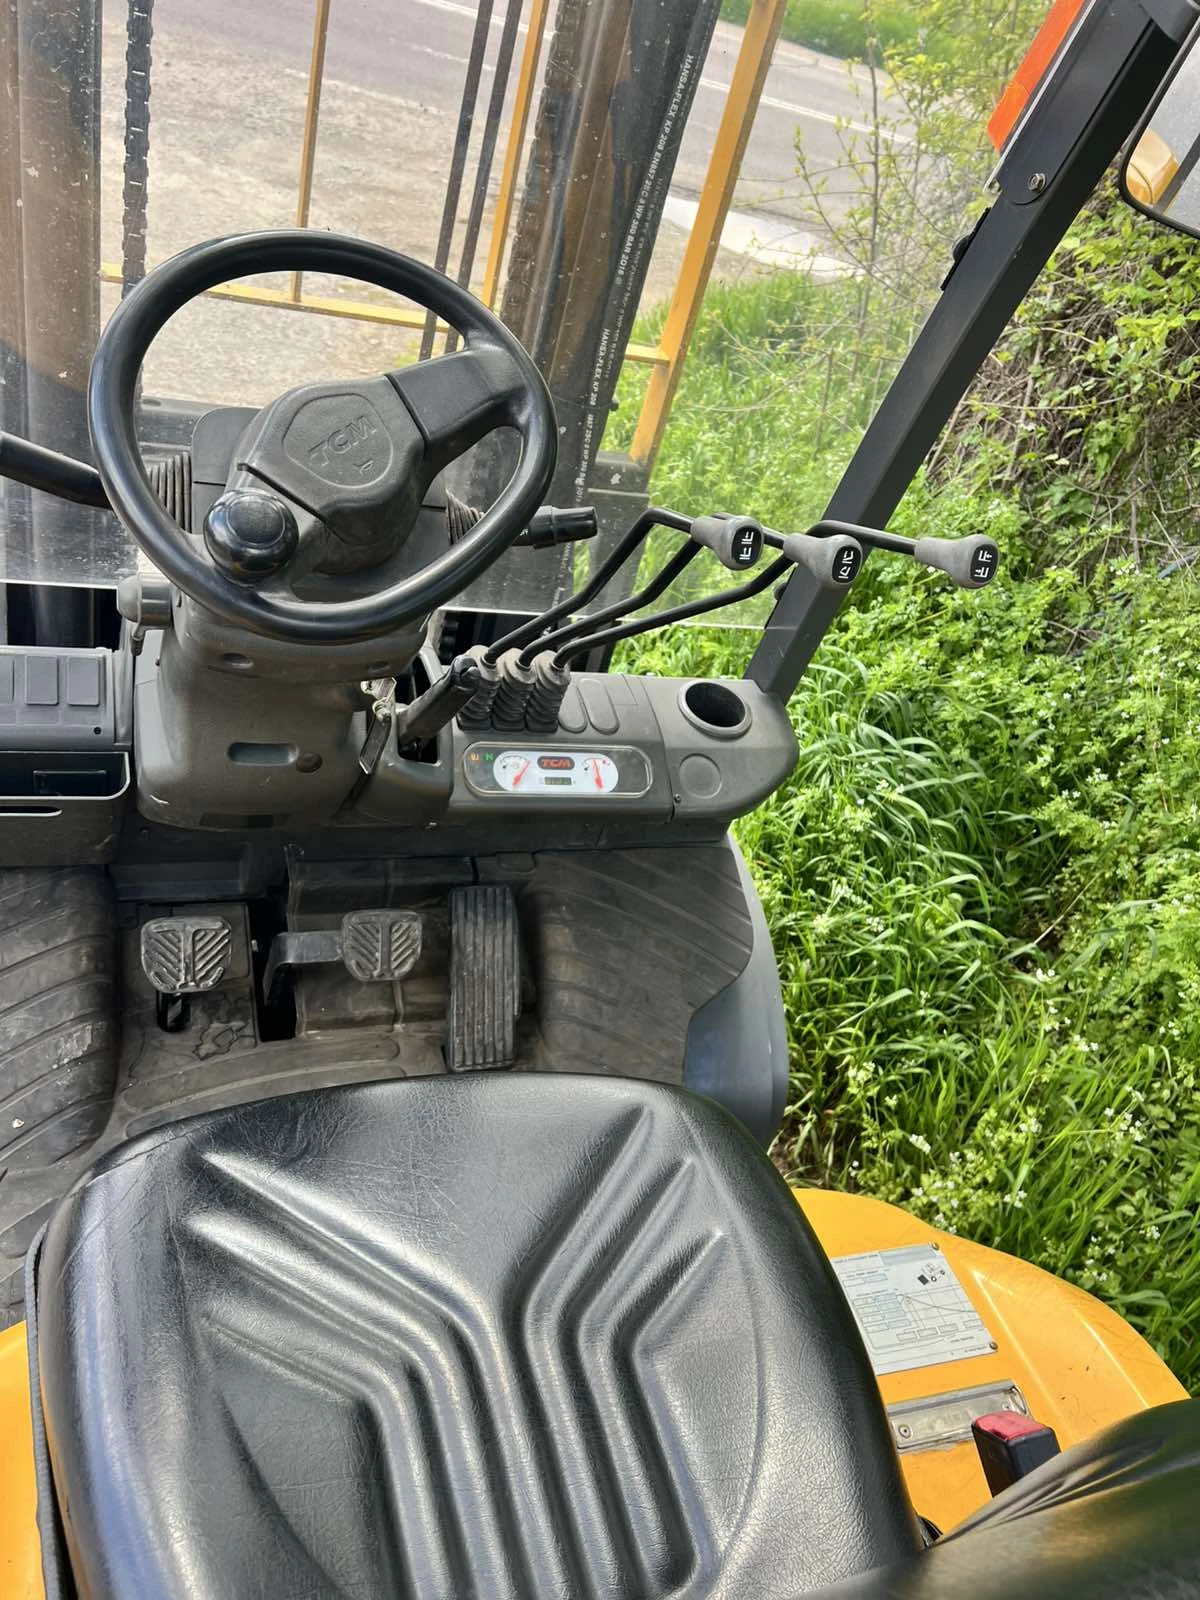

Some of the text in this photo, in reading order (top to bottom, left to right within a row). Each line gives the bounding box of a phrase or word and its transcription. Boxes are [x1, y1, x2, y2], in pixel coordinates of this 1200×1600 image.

[667, 54, 694, 117] HANSA-FLEX
[662, 119, 672, 133] KP
[623, 234, 634, 253] BAR
[308, 415, 377, 467] TCM
[542, 758, 570, 769] TCM
